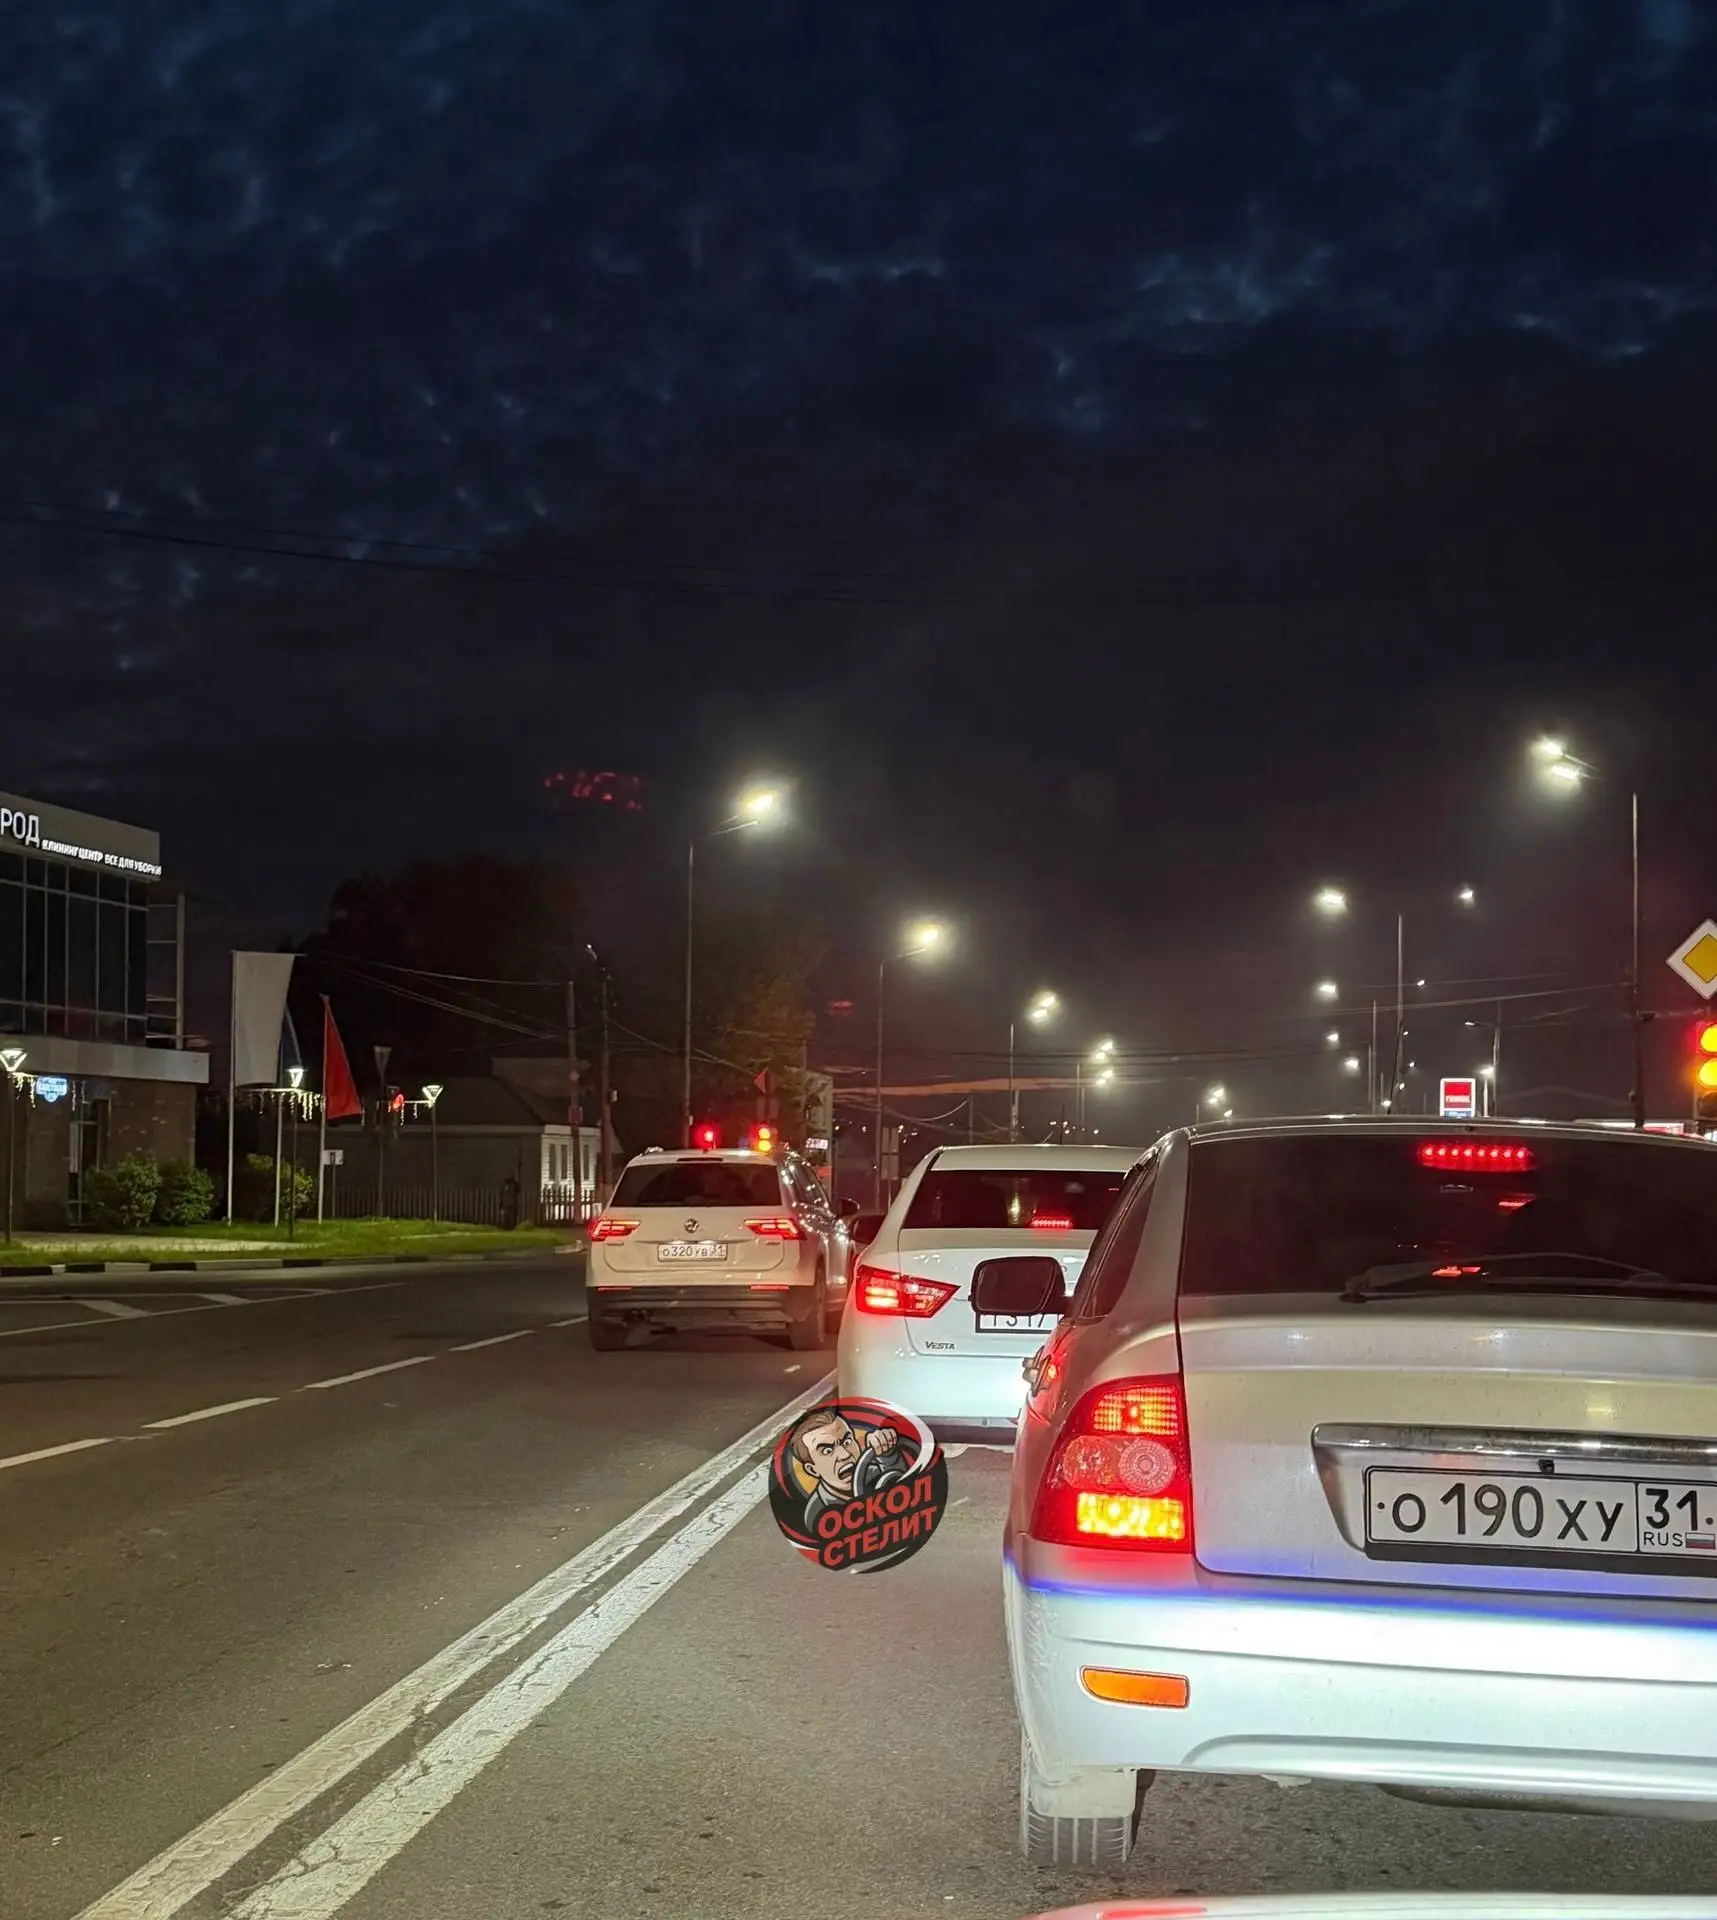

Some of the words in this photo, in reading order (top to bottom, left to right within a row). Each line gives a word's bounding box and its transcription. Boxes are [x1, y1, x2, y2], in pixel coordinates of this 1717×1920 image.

[0, 808, 40, 848] РОД
[78, 848, 104, 862] ЦЕНТР
[104, 853, 119, 866] ВСЕ
[118, 857, 134, 869] ДЛЯ
[133, 861, 162, 876] УБОРКИ
[1645, 1488, 1699, 1531] 31
[1643, 1532, 1684, 1547] RUS
